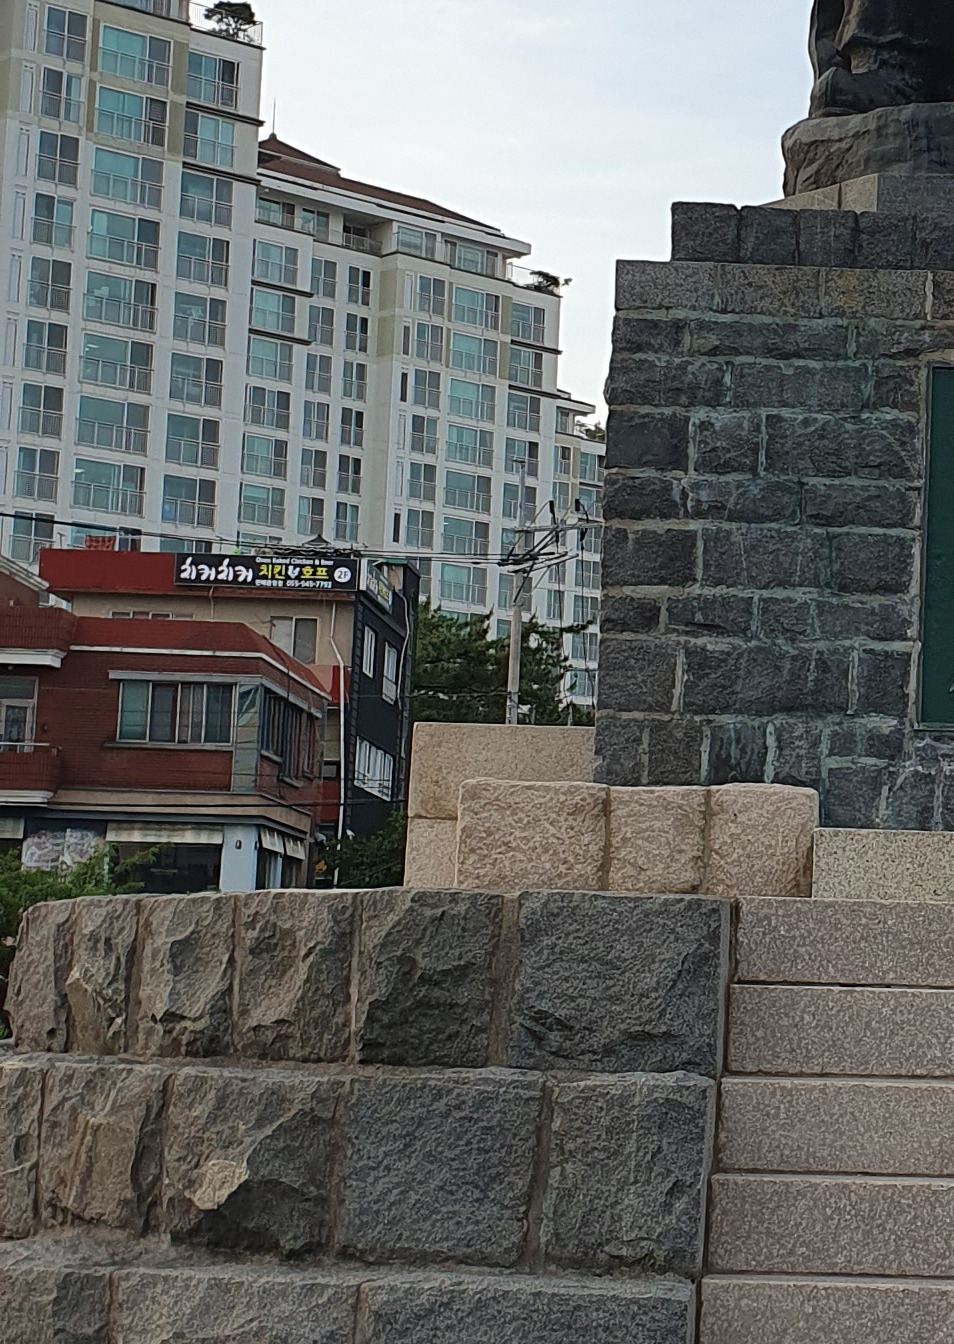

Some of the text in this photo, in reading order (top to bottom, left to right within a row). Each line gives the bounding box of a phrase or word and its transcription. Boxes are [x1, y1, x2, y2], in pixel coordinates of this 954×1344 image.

[180, 557, 253, 583] 치커치커
[259, 564, 329, 579] 치킨 호프
[337, 570, 349, 579] 2F
